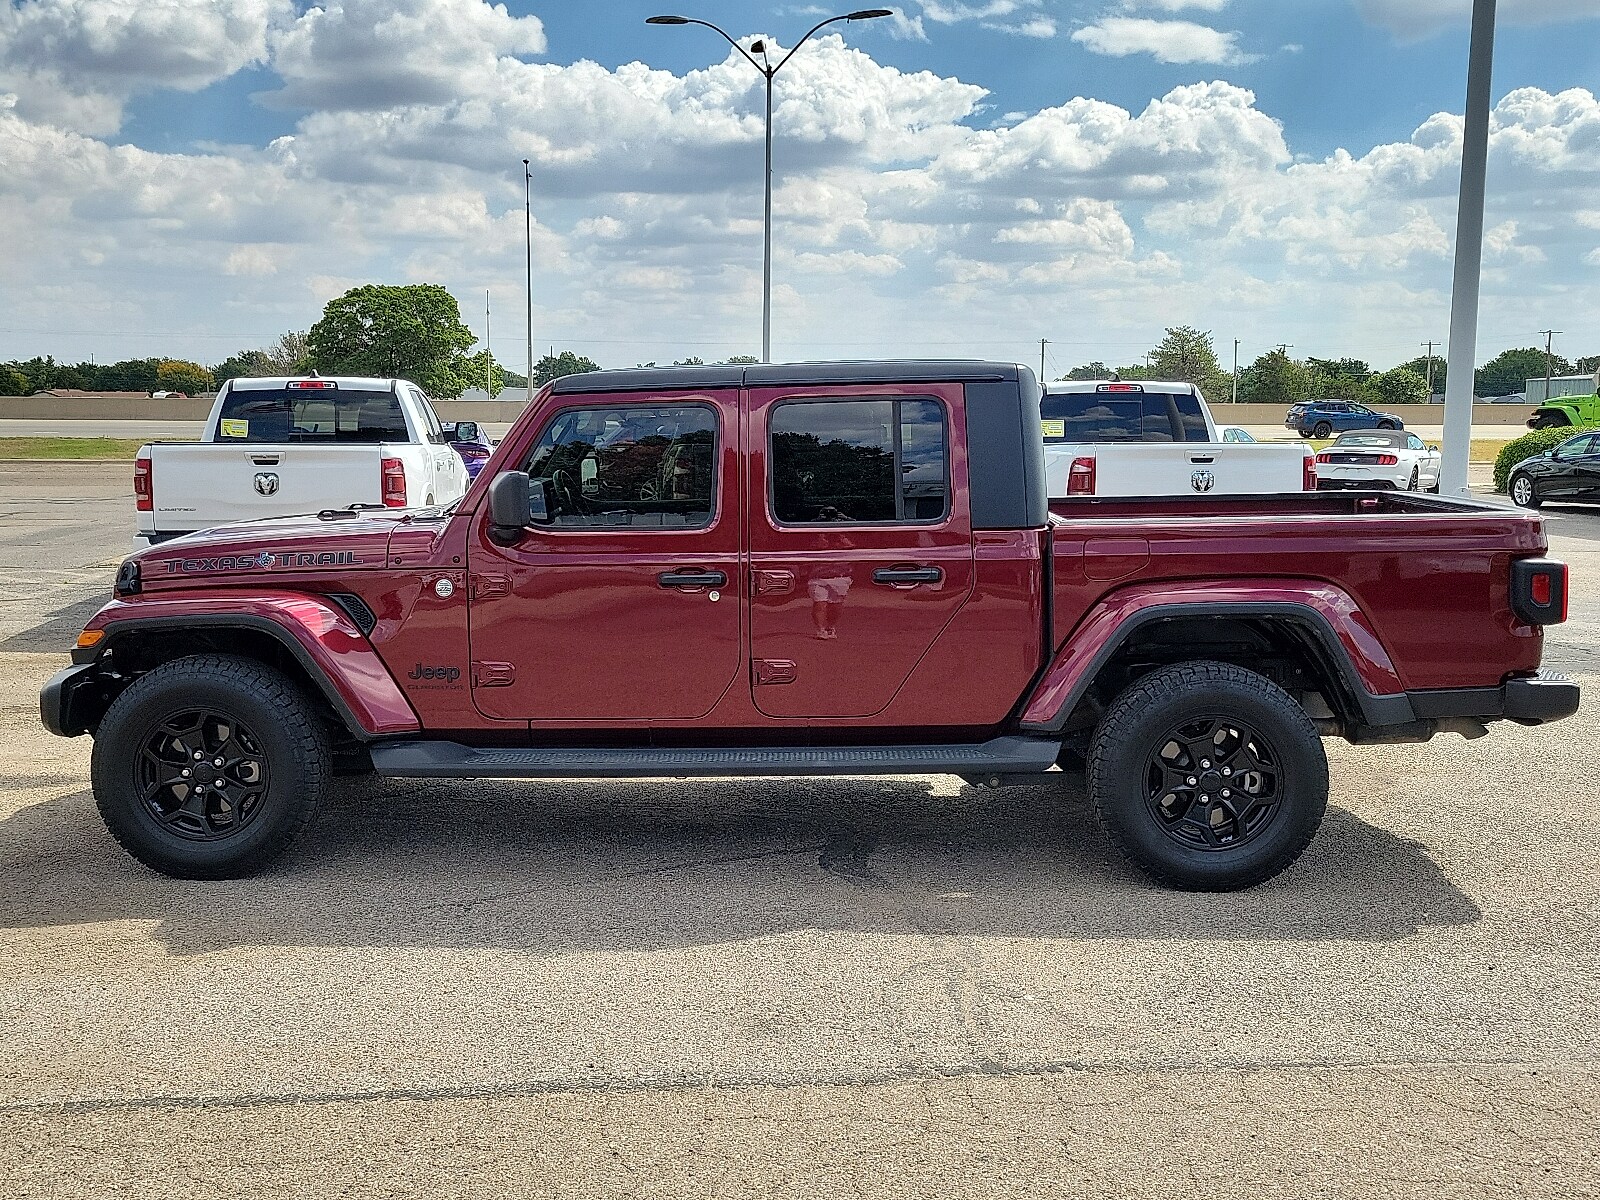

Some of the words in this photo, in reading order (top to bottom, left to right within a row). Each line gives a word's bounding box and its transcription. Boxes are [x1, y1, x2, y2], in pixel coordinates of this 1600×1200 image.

[163, 555, 255, 573] TEXAS
[274, 551, 364, 567] TRAIL
[408, 661, 460, 683] Jeep
